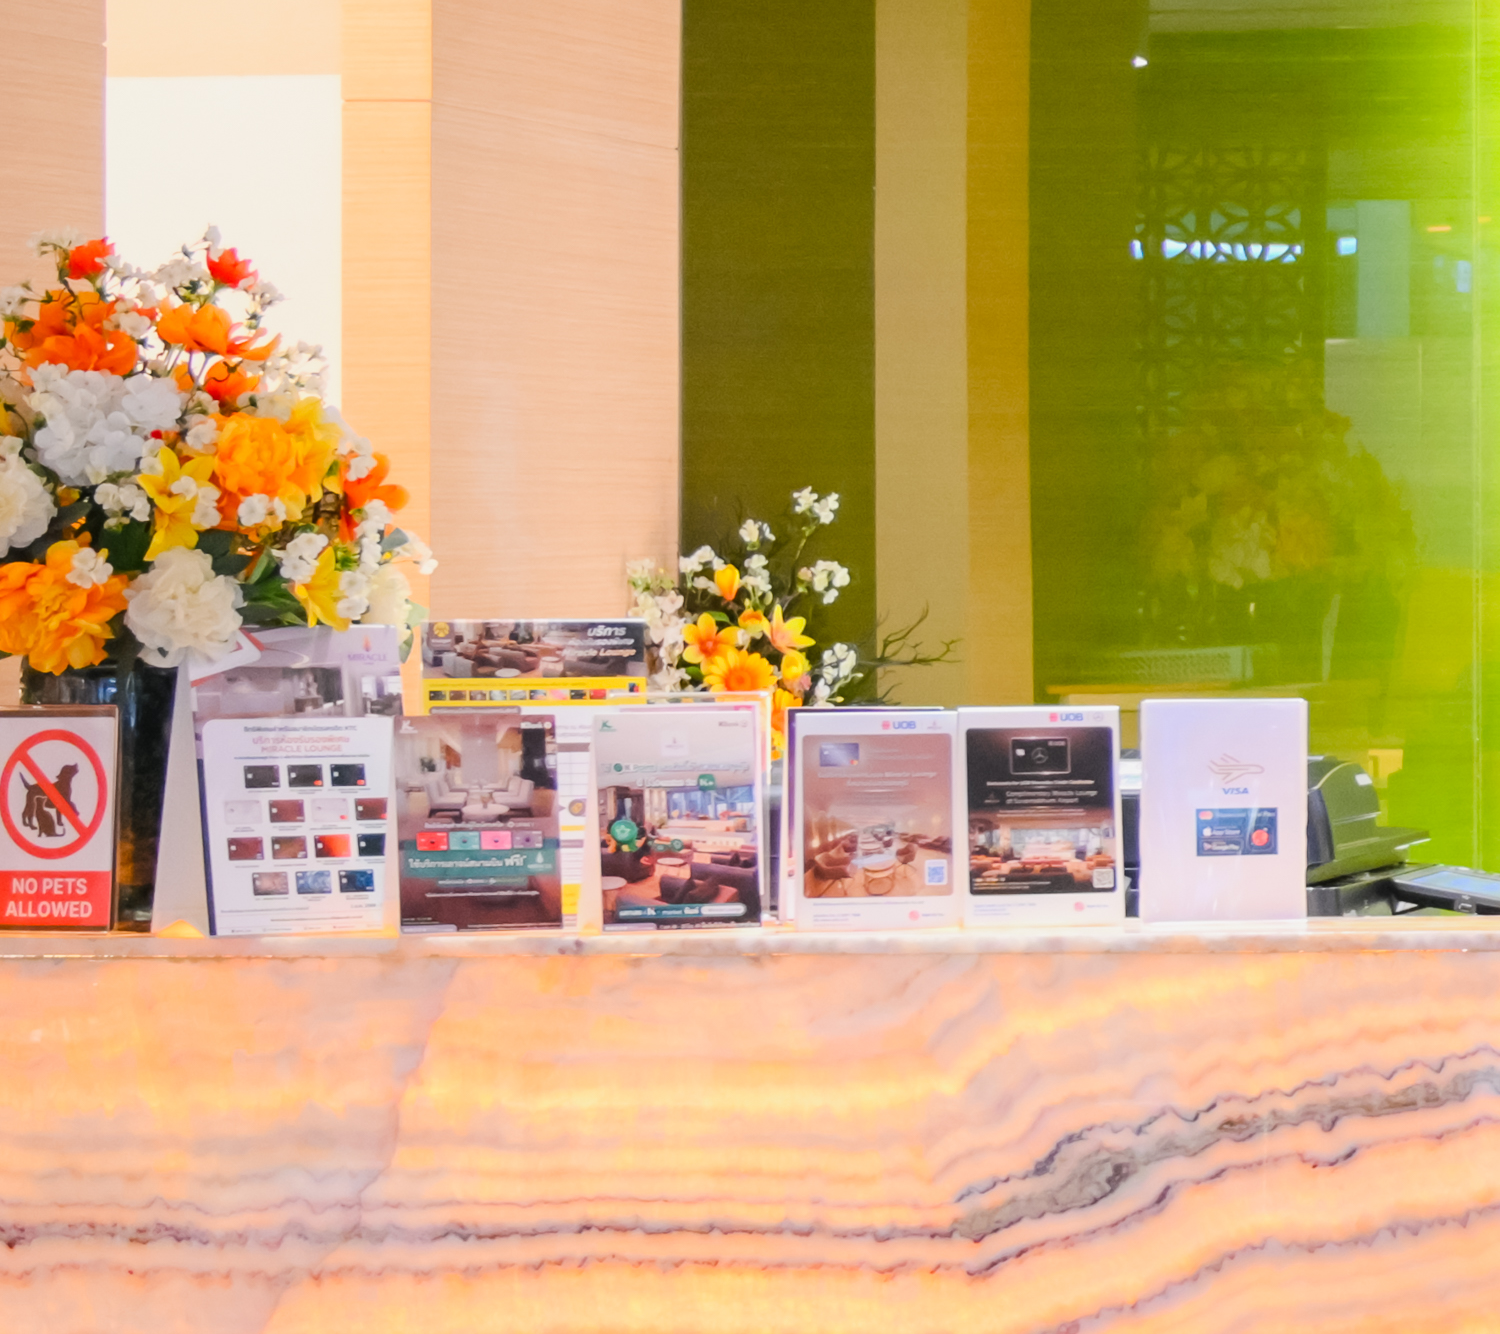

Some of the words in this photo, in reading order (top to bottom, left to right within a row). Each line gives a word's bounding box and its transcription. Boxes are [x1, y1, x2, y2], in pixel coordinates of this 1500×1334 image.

[1060, 713, 1084, 722] UOB
[893, 721, 917, 730] UOB
[1222, 787, 1249, 795] VISA
[12, 877, 38, 895] NO
[42, 877, 88, 895] PETS
[5, 901, 93, 918] ALLOWED
